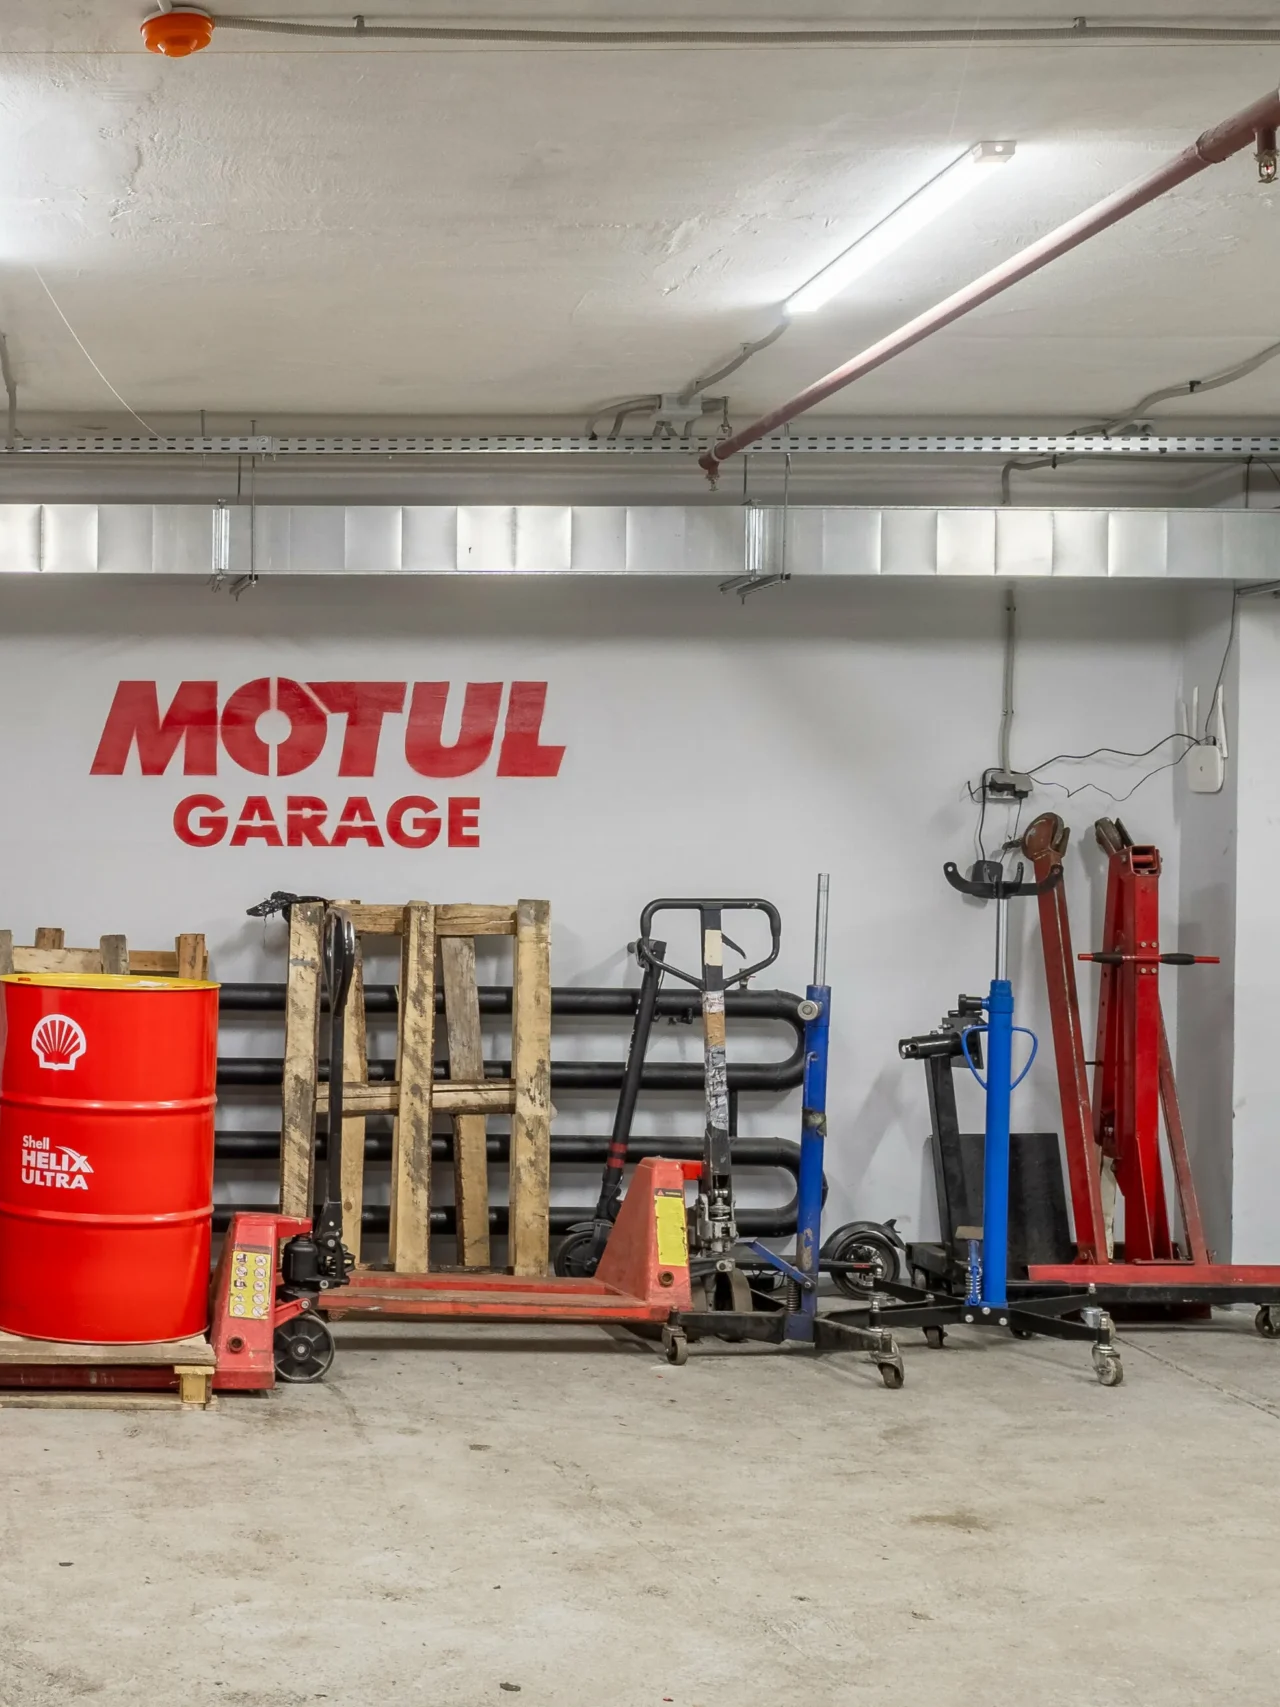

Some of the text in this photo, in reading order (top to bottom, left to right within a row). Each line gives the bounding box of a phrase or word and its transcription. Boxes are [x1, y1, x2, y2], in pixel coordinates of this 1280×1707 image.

[89, 677, 566, 778] MOTUL
[173, 794, 480, 848] GARAGE
[22, 1135, 50, 1150] Shell
[21, 1146, 94, 1173] HELIX
[21, 1168, 89, 1190] ULTRA
